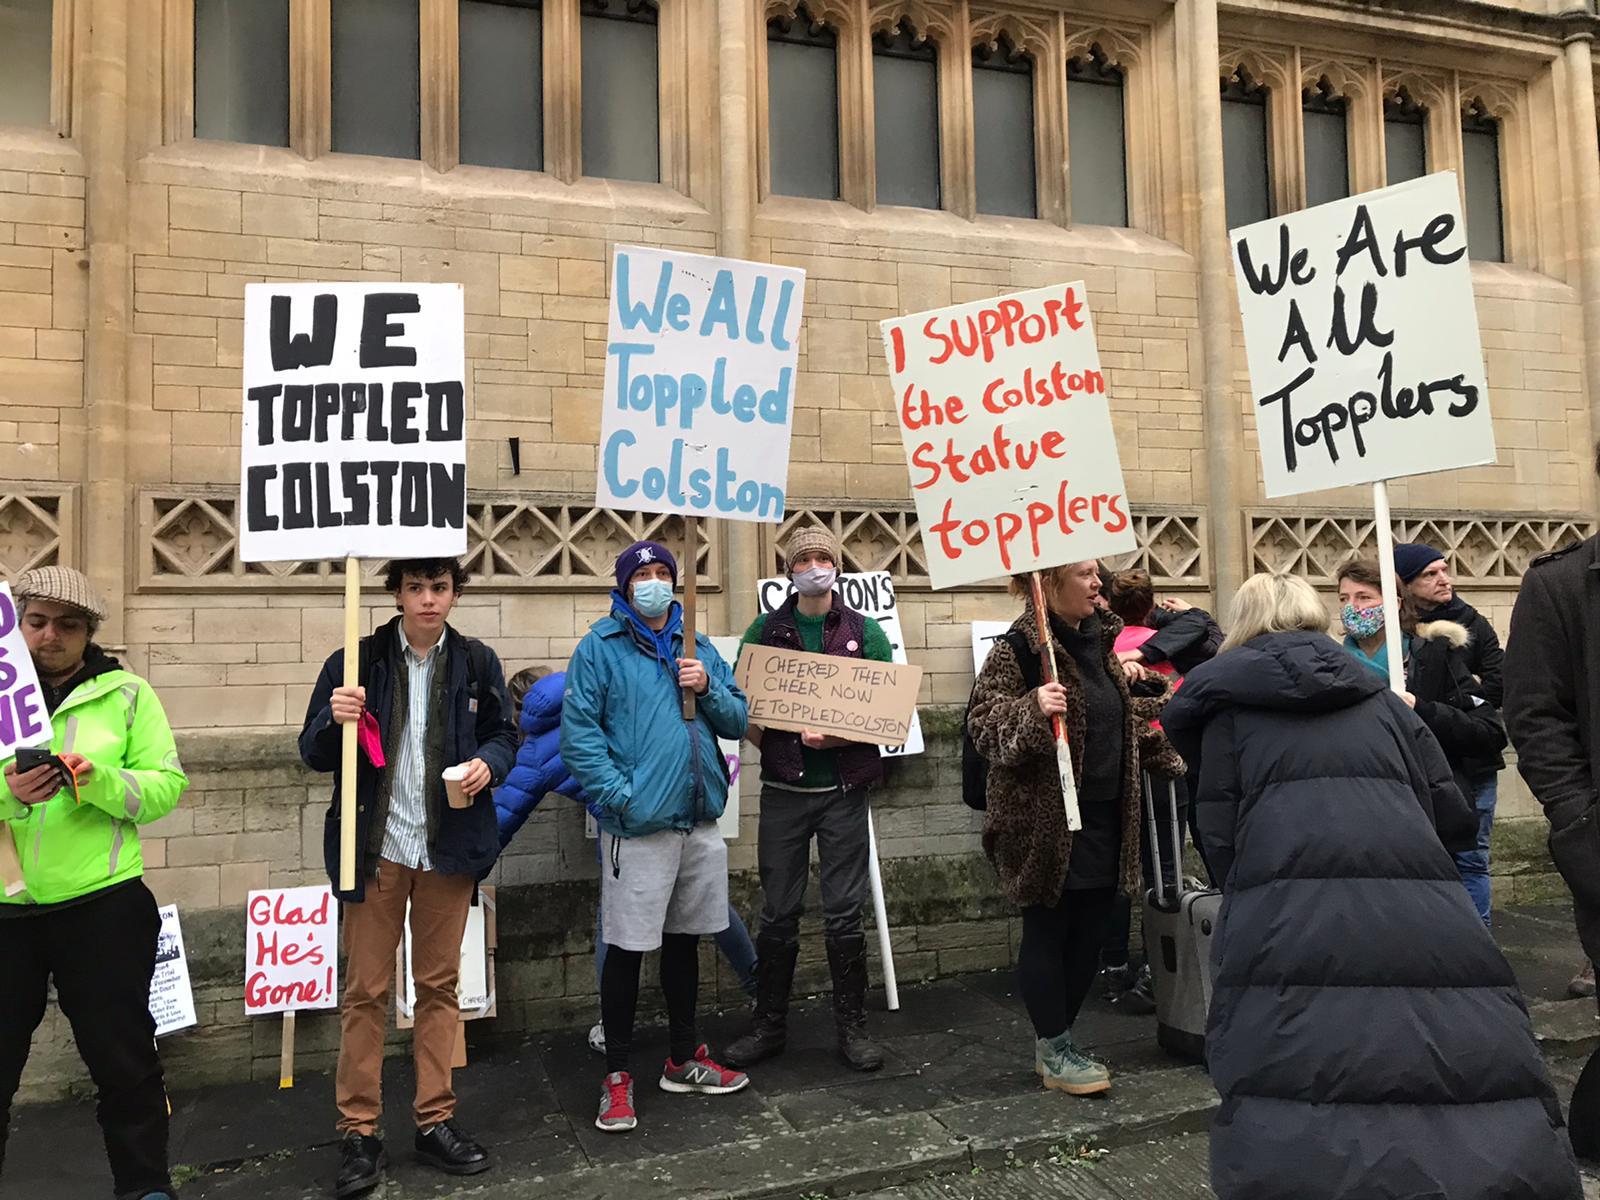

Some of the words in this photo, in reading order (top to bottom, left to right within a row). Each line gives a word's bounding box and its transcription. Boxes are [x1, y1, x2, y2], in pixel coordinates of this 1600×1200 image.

[1237, 223, 1316, 296] We
[1336, 204, 1467, 278] Are
[270, 293, 421, 371] WE
[616, 253, 690, 333] We
[699, 270, 795, 351] All
[1278, 280, 1394, 363] All
[890, 326, 906, 373] I
[248, 381, 464, 445] TOPPLED
[608, 342, 792, 429] Toppled
[902, 383, 969, 430] the
[982, 361, 1105, 414] Colston
[1258, 350, 1479, 473] Topplers
[604, 429, 785, 518] Colston
[912, 424, 1067, 489] Statue
[248, 461, 465, 531] COLSTON
[929, 479, 1127, 570] topplers
[747, 652, 753, 671] I
[764, 656, 839, 680] CHEERED
[851, 666, 897, 687] THEN
[763, 677, 822, 700] CHEER
[830, 684, 873, 704] NOW
[249, 892, 329, 925] Glad
[255, 930, 324, 966] He's
[244, 966, 333, 1008] Gone!
